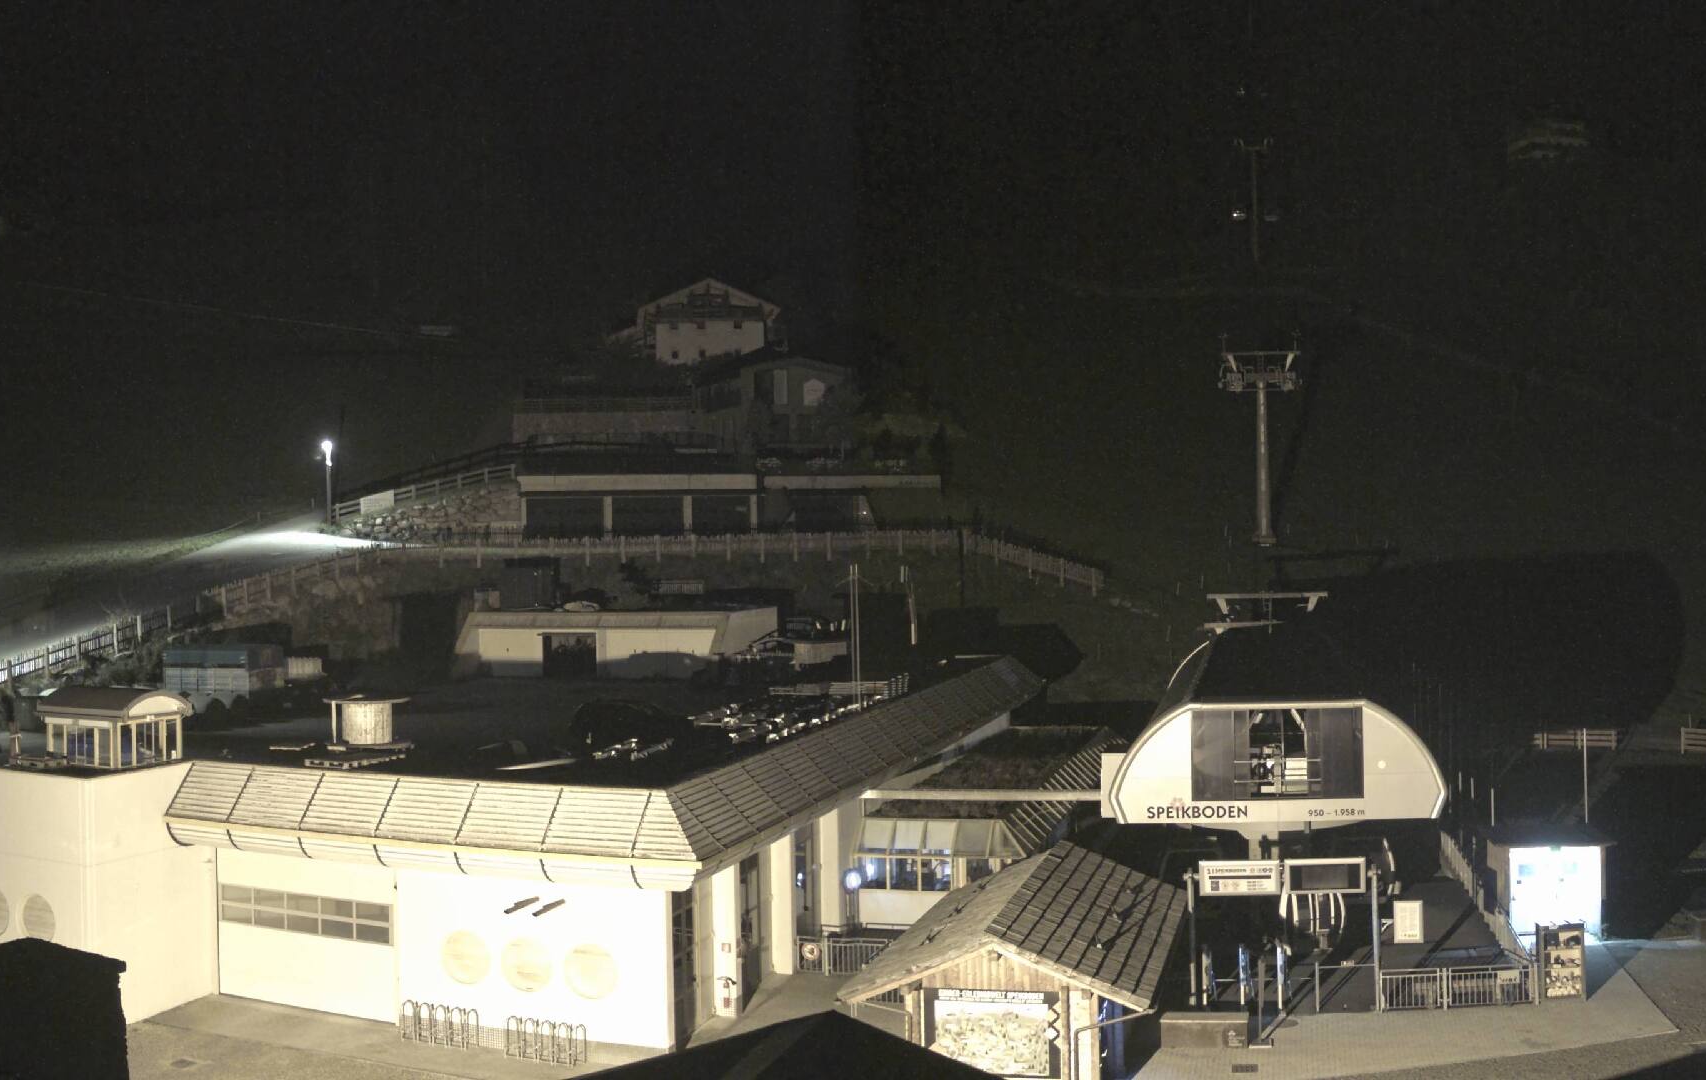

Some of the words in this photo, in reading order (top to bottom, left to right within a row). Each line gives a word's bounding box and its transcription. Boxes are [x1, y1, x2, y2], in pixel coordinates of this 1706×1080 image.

[1146, 805, 1248, 819] SPEIKBODEN
[1308, 809, 1325, 817] 950
[1334, 808, 1356, 816] 1.958
